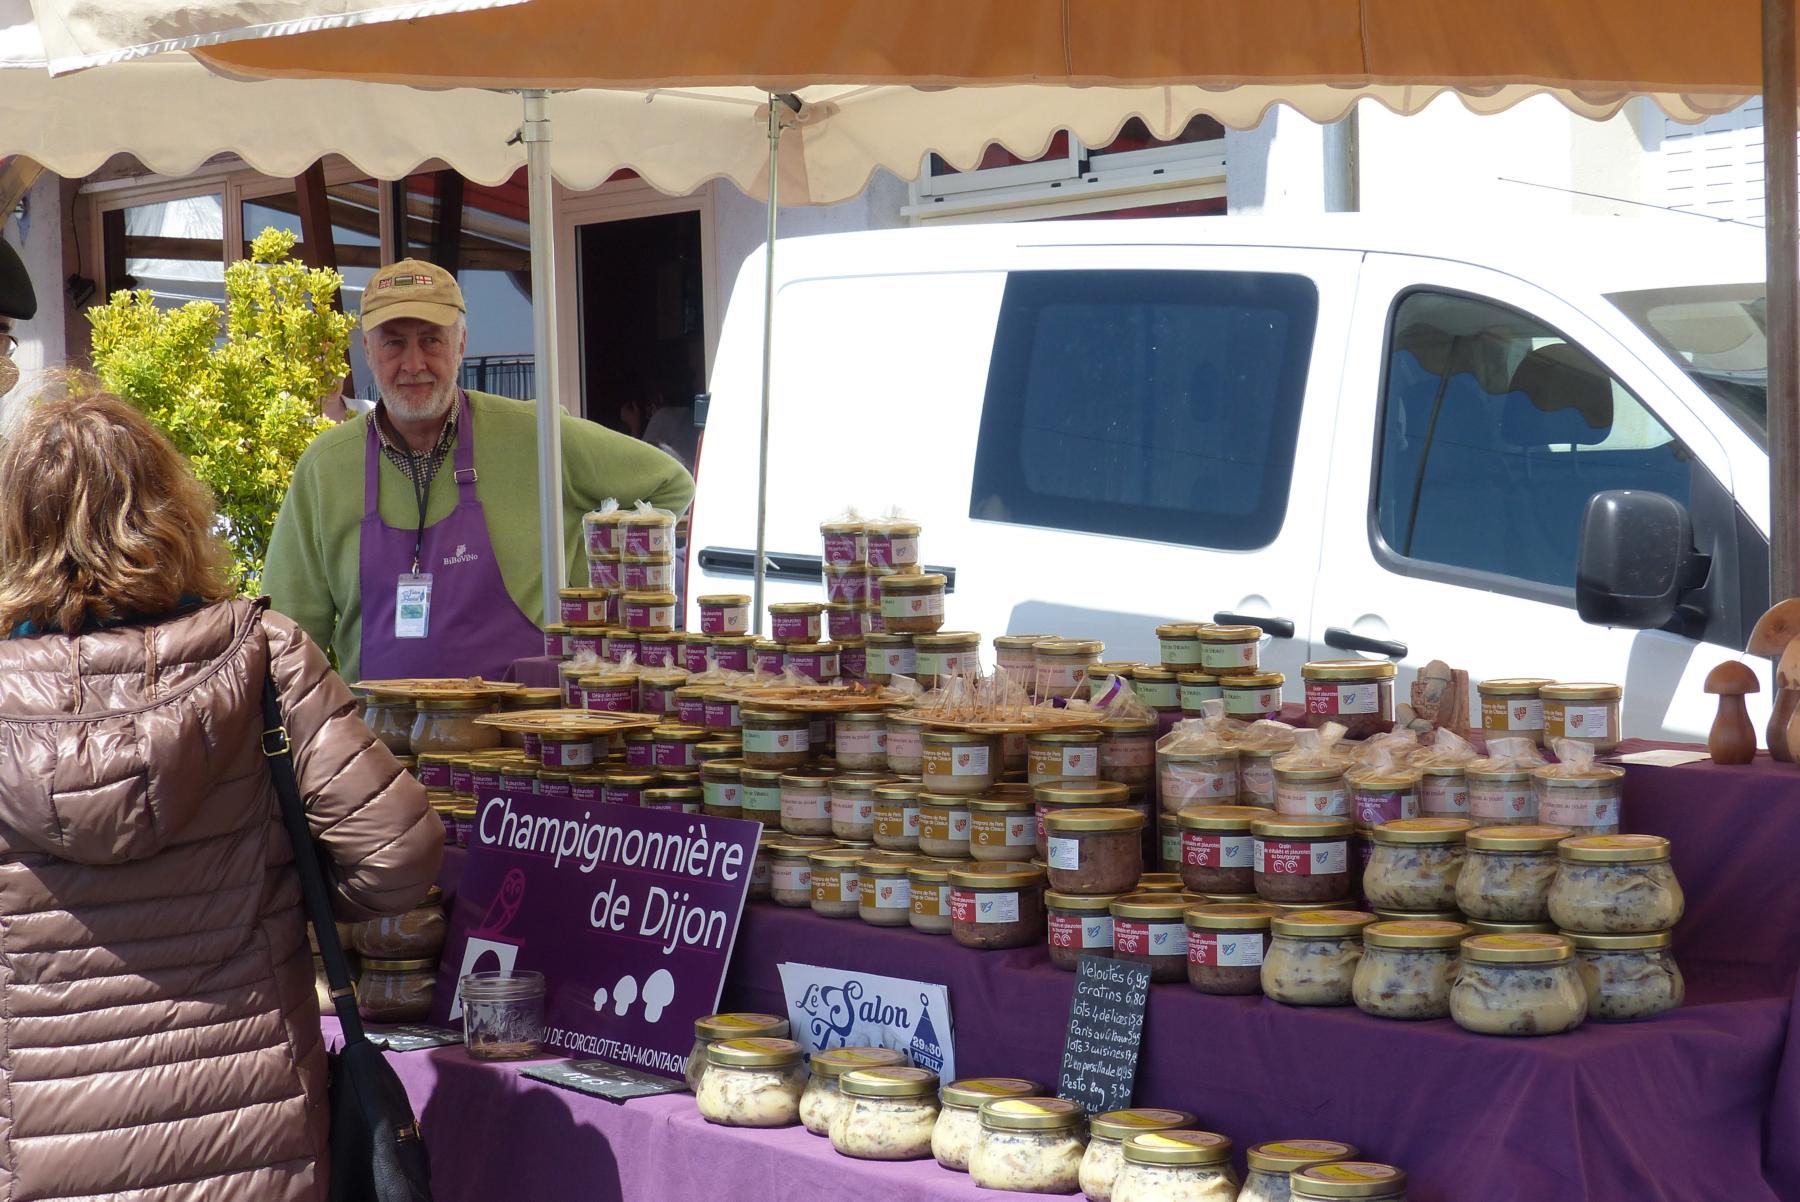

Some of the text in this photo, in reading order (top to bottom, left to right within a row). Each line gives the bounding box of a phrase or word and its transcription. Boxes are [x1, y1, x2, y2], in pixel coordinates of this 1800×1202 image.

[479, 797, 744, 882] Champignonnière
[590, 878, 728, 955] de Dijon
[1081, 961, 1148, 990] Veloutés 6,95
[1078, 981, 1122, 1003] Gratins
[795, 980, 911, 1037] Le Salon
[550, 1027, 564, 1047] DE
[1070, 1019, 1093, 1038] Paris
[912, 1035, 925, 1050] 29
[929, 1042, 941, 1058] 30
[913, 1051, 940, 1072] AVRIL
[1062, 1073, 1087, 1091] Pesto
